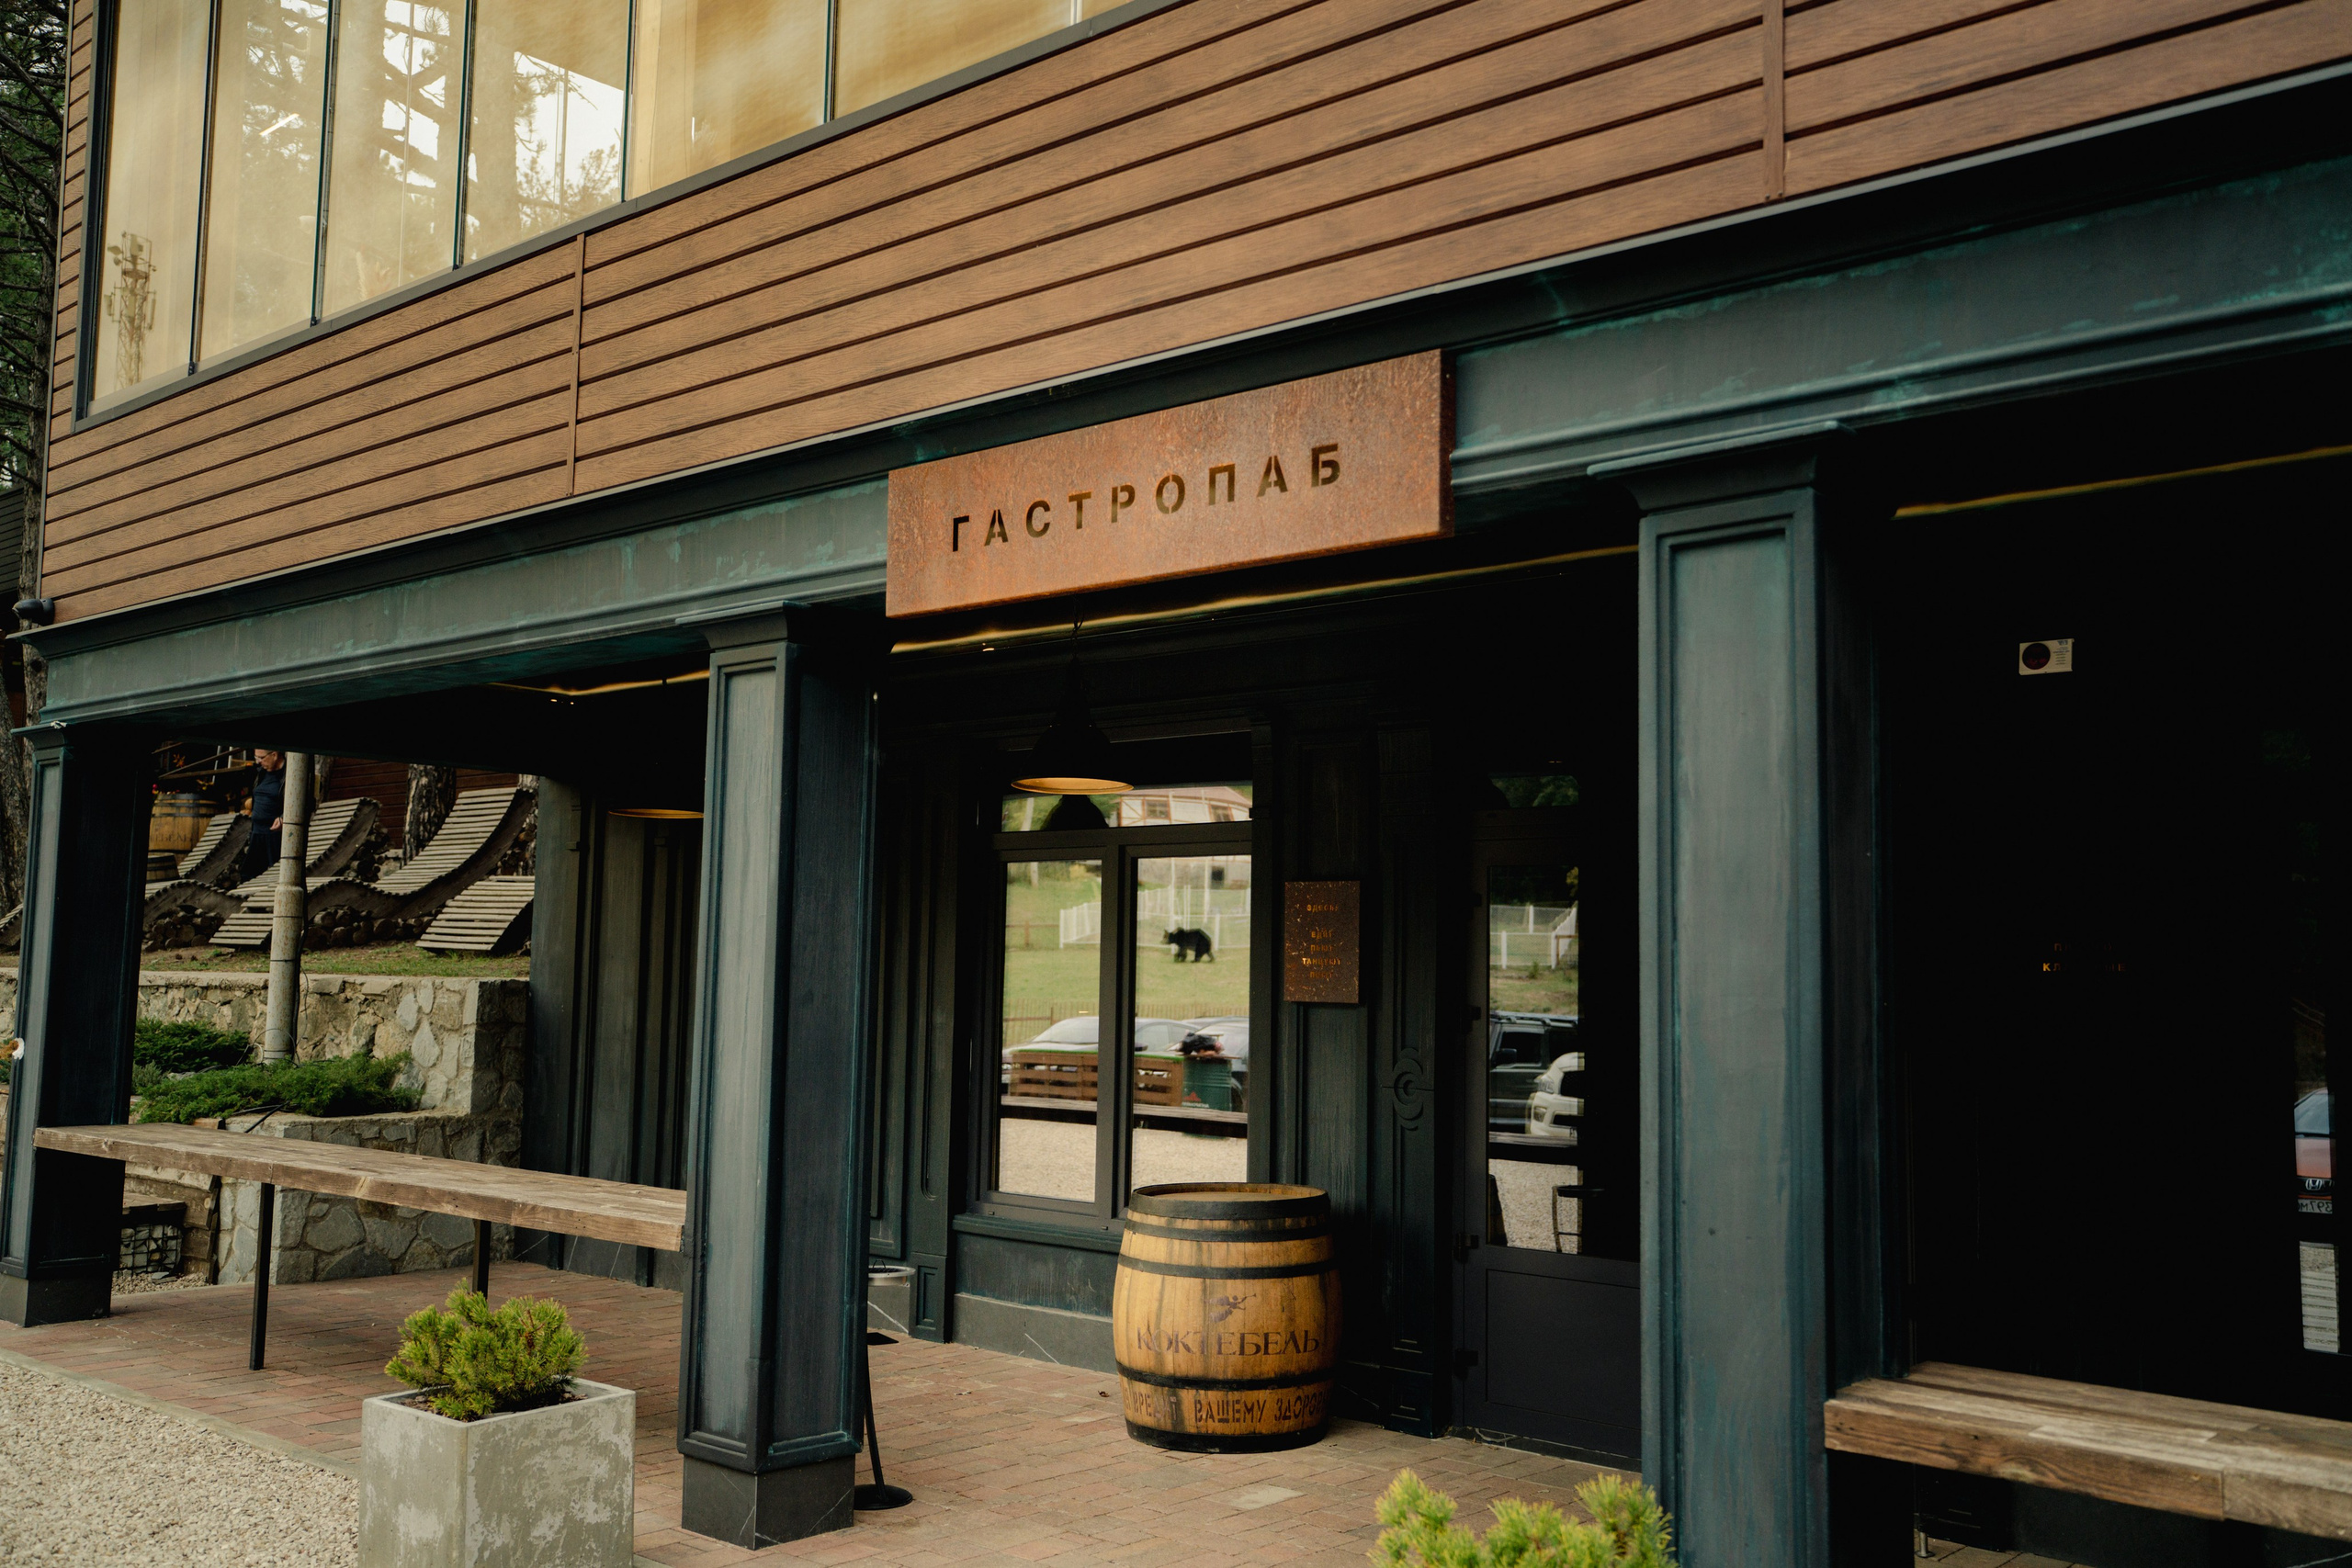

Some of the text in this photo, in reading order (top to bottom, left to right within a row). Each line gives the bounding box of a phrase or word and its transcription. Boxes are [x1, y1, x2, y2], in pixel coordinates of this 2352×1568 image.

[951, 443, 1342, 553] ГАСТРОПАБ
[1302, 957, 1340, 965] ТАНЦУЮТ
[1137, 1327, 1319, 1356] КОКТЕБЕЛЬ
[1193, 1398, 1267, 1424] ВАШЕМУ
